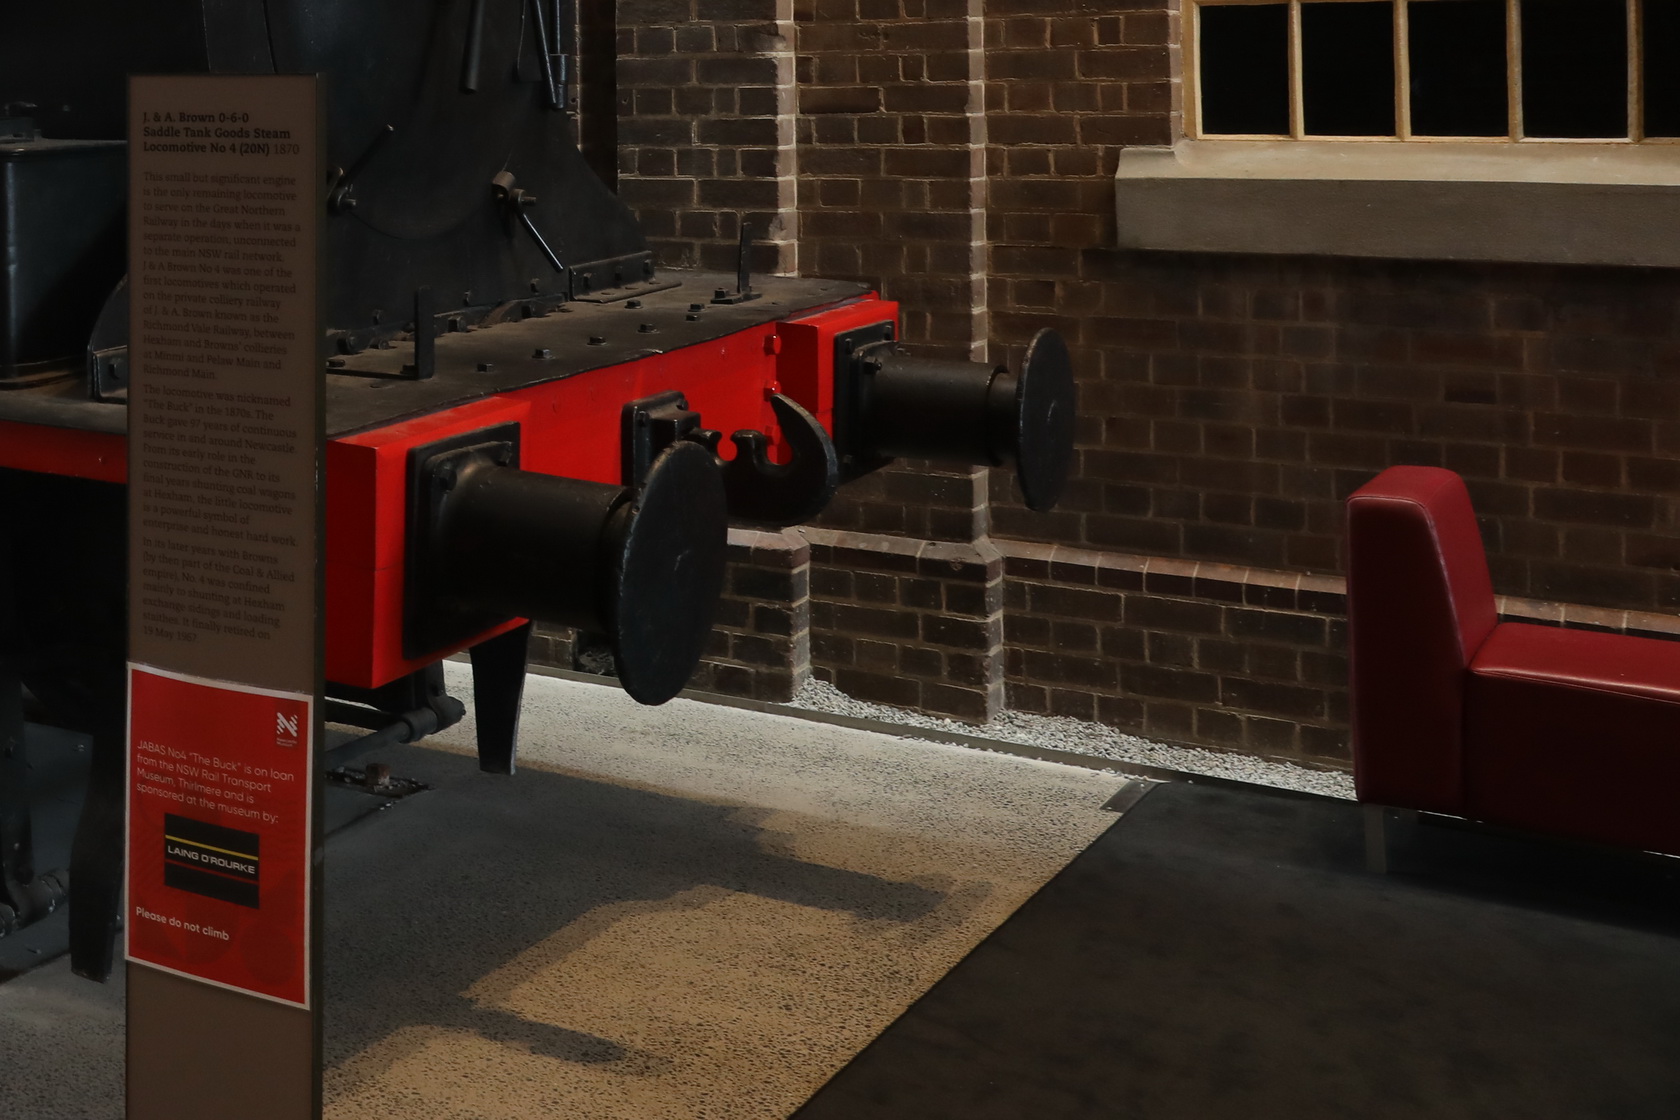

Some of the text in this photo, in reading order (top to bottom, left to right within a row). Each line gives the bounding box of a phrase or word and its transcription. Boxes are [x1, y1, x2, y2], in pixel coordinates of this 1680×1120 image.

[143, 113, 249, 123] J. & A. Brown 0-6-0
[143, 127, 291, 139] Saddle Tank Goods Steam
[143, 142, 300, 156] Locomotive No 4 (20N) 1870
[145, 172, 296, 187] This small but significant engine
[153, 187, 168, 197] the
[170, 187, 191, 200] only
[192, 189, 243, 201] remaining
[242, 189, 297, 200] locomotive
[155, 204, 179, 212] serve
[195, 203, 211, 213] the
[213, 204, 239, 214] Great
[240, 205, 286, 216] Northern
[143, 234, 183, 244] separate
[233, 237, 297, 247] unconnected
[153, 246, 170, 257] the
[172, 248, 196, 258] main
[198, 248, 222, 259] NSW
[224, 250, 240, 260] rail
[143, 276, 297, 294] first locomotives which operated
[157, 291, 173, 301] the
[174, 293, 207, 305] private
[209, 294, 244, 308] colliery
[246, 297, 281, 310] railway
[143, 320, 190, 333] Richmond
[191, 323, 211, 334] Vale
[253, 327, 295, 340] between
[142, 335, 182, 347] Hexham
[183, 338, 202, 348] and
[243, 342, 288, 354] collieries
[154, 351, 185, 362] Minmi
[186, 354, 205, 364] and
[206, 354, 234, 366] Pelaw
[235, 356, 262, 368] Main
[262, 359, 282, 369] and
[143, 364, 190, 377] Richmond
[144, 384, 291, 405] The locomotive was nicknamed
[206, 404, 223, 414] the
[255, 408, 274, 419] The
[143, 414, 166, 425] Buck
[166, 418, 188, 428] gave
[203, 422, 229, 432] years
[242, 425, 298, 437] continuous
[143, 430, 175, 441] service
[188, 434, 207, 444] and
[209, 437, 243, 447] around
[143, 443, 167, 455] From
[168, 446, 181, 456] its
[182, 449, 206, 462] early
[207, 451, 226, 461] role
[239, 453, 256, 464] the
[143, 460, 201, 473] construction
[214, 465, 231, 476] the
[232, 467, 254, 478] GNR
[268, 471, 281, 481] its
[143, 472, 296, 499] final years shunting coal wagons
[142, 519, 189, 533] enterprise
[191, 525, 210, 535] and
[210, 526, 244, 539] honest
[246, 530, 270, 542] hard
[153, 538, 166, 549] its
[167, 540, 190, 552] later
[191, 545, 216, 555] years
[217, 548, 240, 558] with
[242, 549, 278, 563] Browns
[143, 583, 174, 597] mainly
[188, 588, 231, 605] shunting
[244, 596, 285, 610] Hexham
[155, 627, 174, 641] May
[177, 629, 197, 641] 1967
[137, 740, 165, 755] JABAS
[168, 747, 186, 760] No4
[244, 764, 251, 774] is
[255, 769, 267, 777] on
[271, 768, 294, 781] loan
[137, 754, 271, 793] from the NSW Rail Transport
[137, 768, 254, 804] Museum, Thirlmere and is
[137, 783, 278, 825] sponsored at the museum by:
[168, 845, 255, 874] LAING O'ROURKE
[136, 906, 229, 940] Please do not climb
